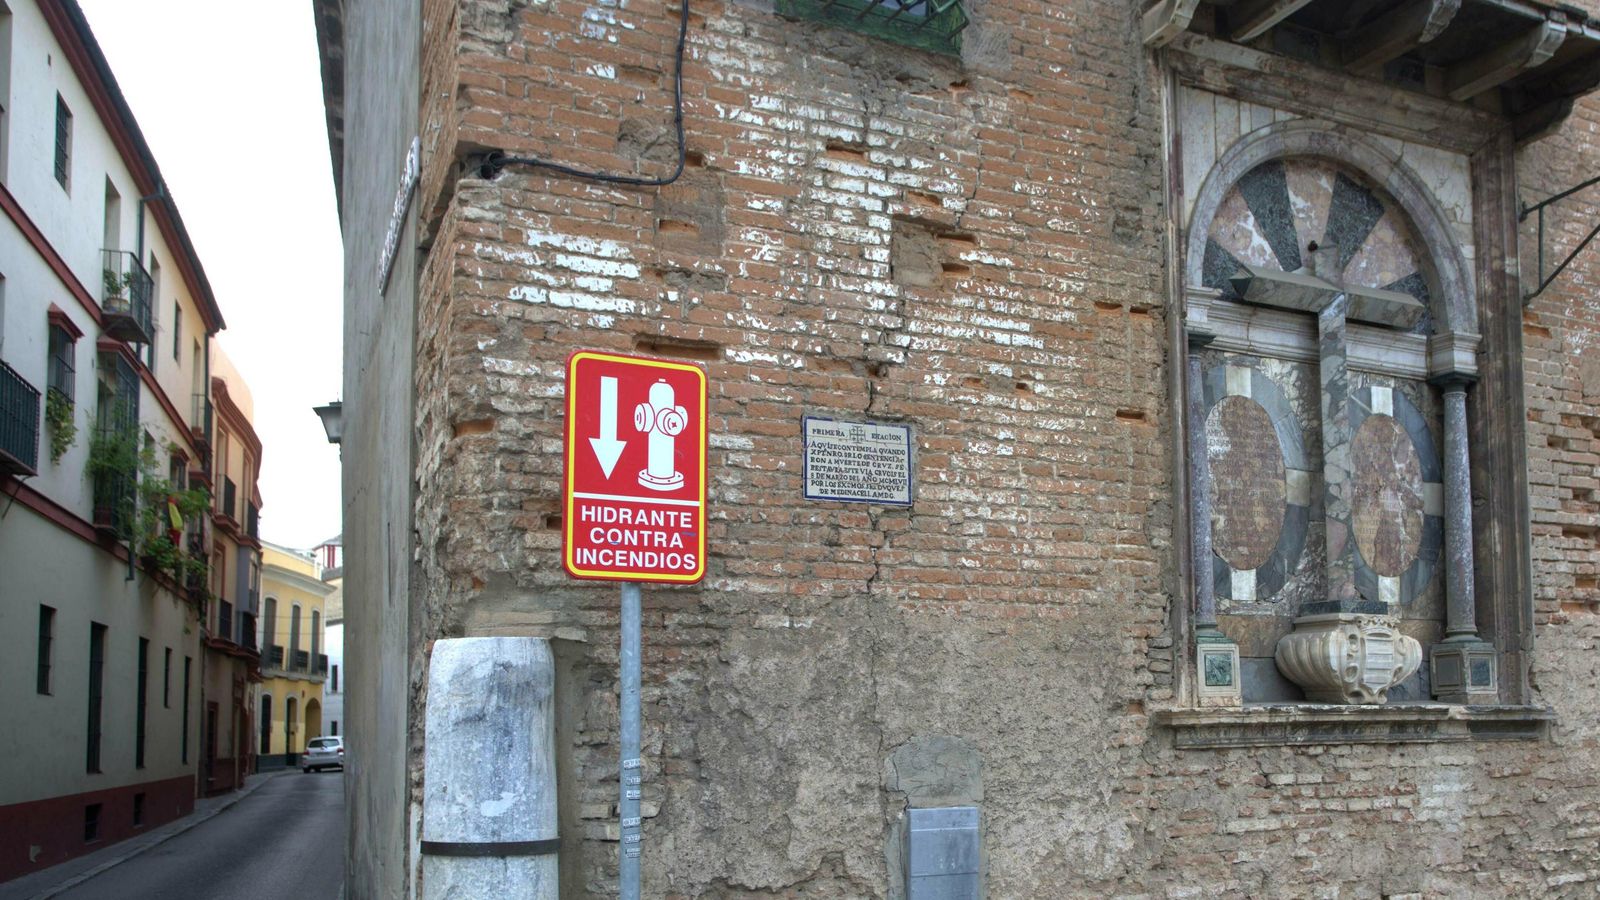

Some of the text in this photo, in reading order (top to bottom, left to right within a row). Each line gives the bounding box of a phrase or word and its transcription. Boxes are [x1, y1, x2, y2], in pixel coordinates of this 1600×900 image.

[812, 428, 845, 436] PRIMERA
[879, 448, 905, 456] QVANDO
[862, 474, 877, 482] AÑO
[581, 505, 692, 528] HIDRANTE
[590, 527, 683, 548] CONTRA
[576, 548, 696, 569] INCENDIOS
